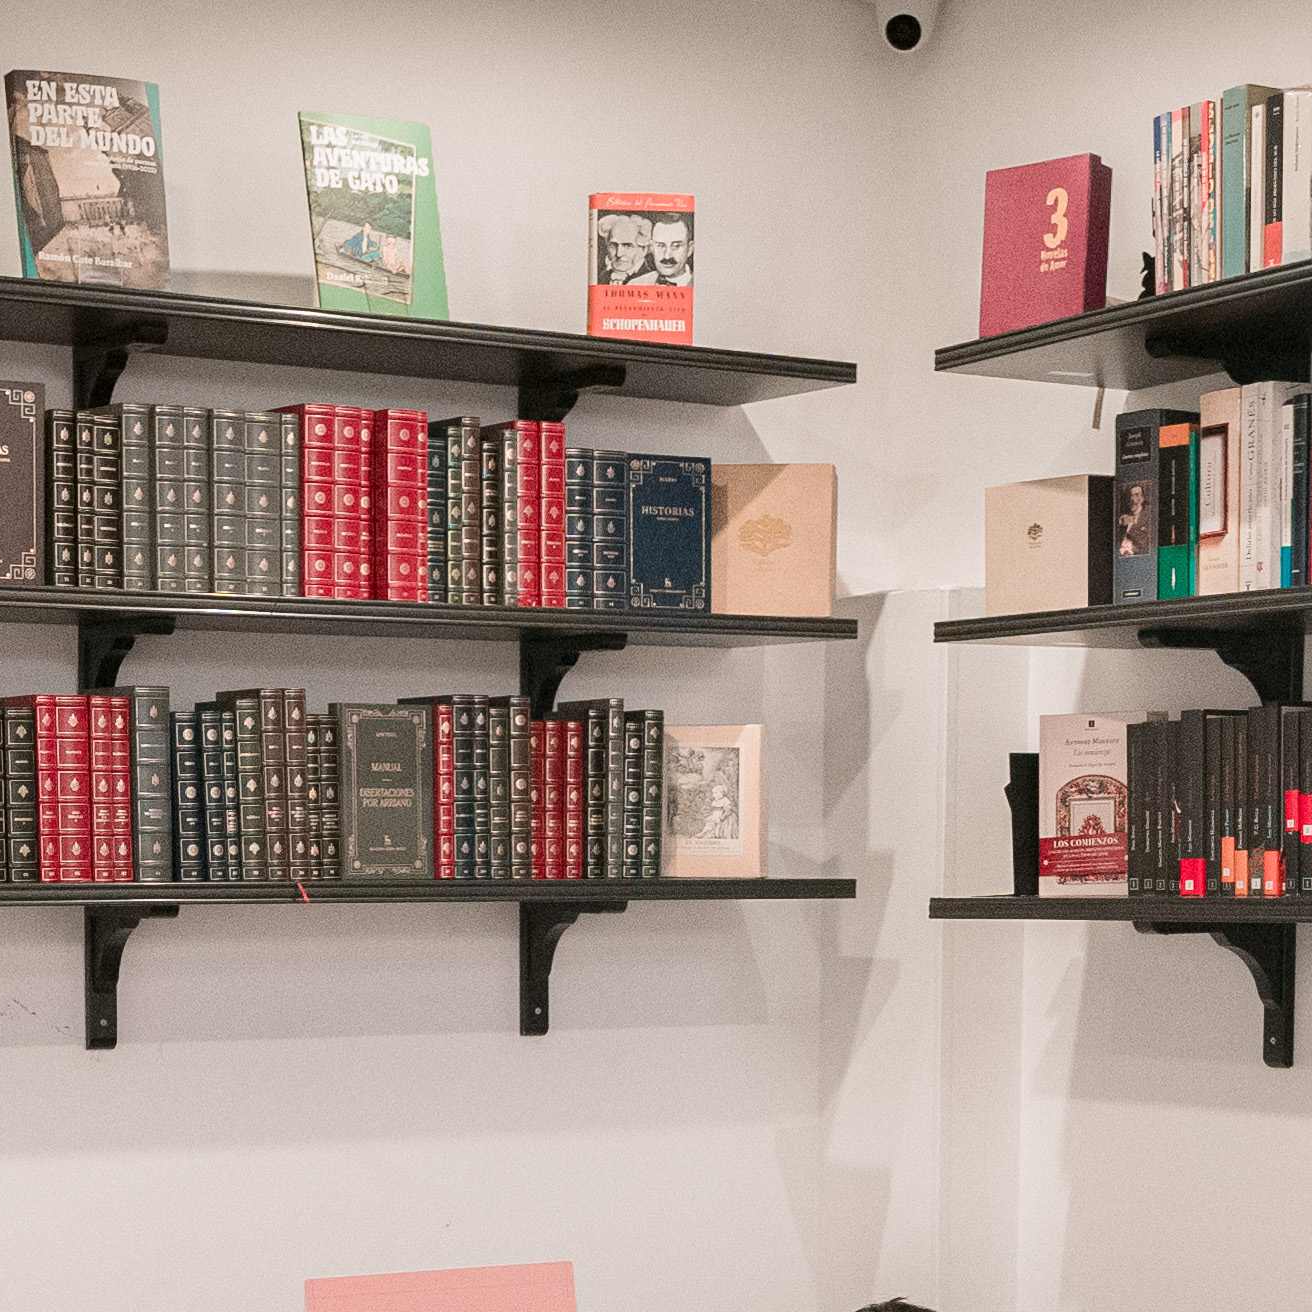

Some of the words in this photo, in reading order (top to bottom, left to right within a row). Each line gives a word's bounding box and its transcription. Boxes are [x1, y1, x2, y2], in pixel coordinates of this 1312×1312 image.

[25, 80, 57, 102] EN
[64, 83, 120, 108] ESTA
[27, 103, 104, 128] PARTE
[29, 126, 74, 148] DEL
[79, 134, 156, 157] MUNDO
[313, 147, 431, 177] AVENTURAS
[314, 169, 343, 189] DE
[1043, 187, 1069, 249] 3
[602, 318, 687, 333] SCHOPENHAUER
[641, 505, 696, 517] HISTORIAS
[1053, 840, 1070, 849] LOS
[1071, 838, 1119, 848] COMIENZOS
